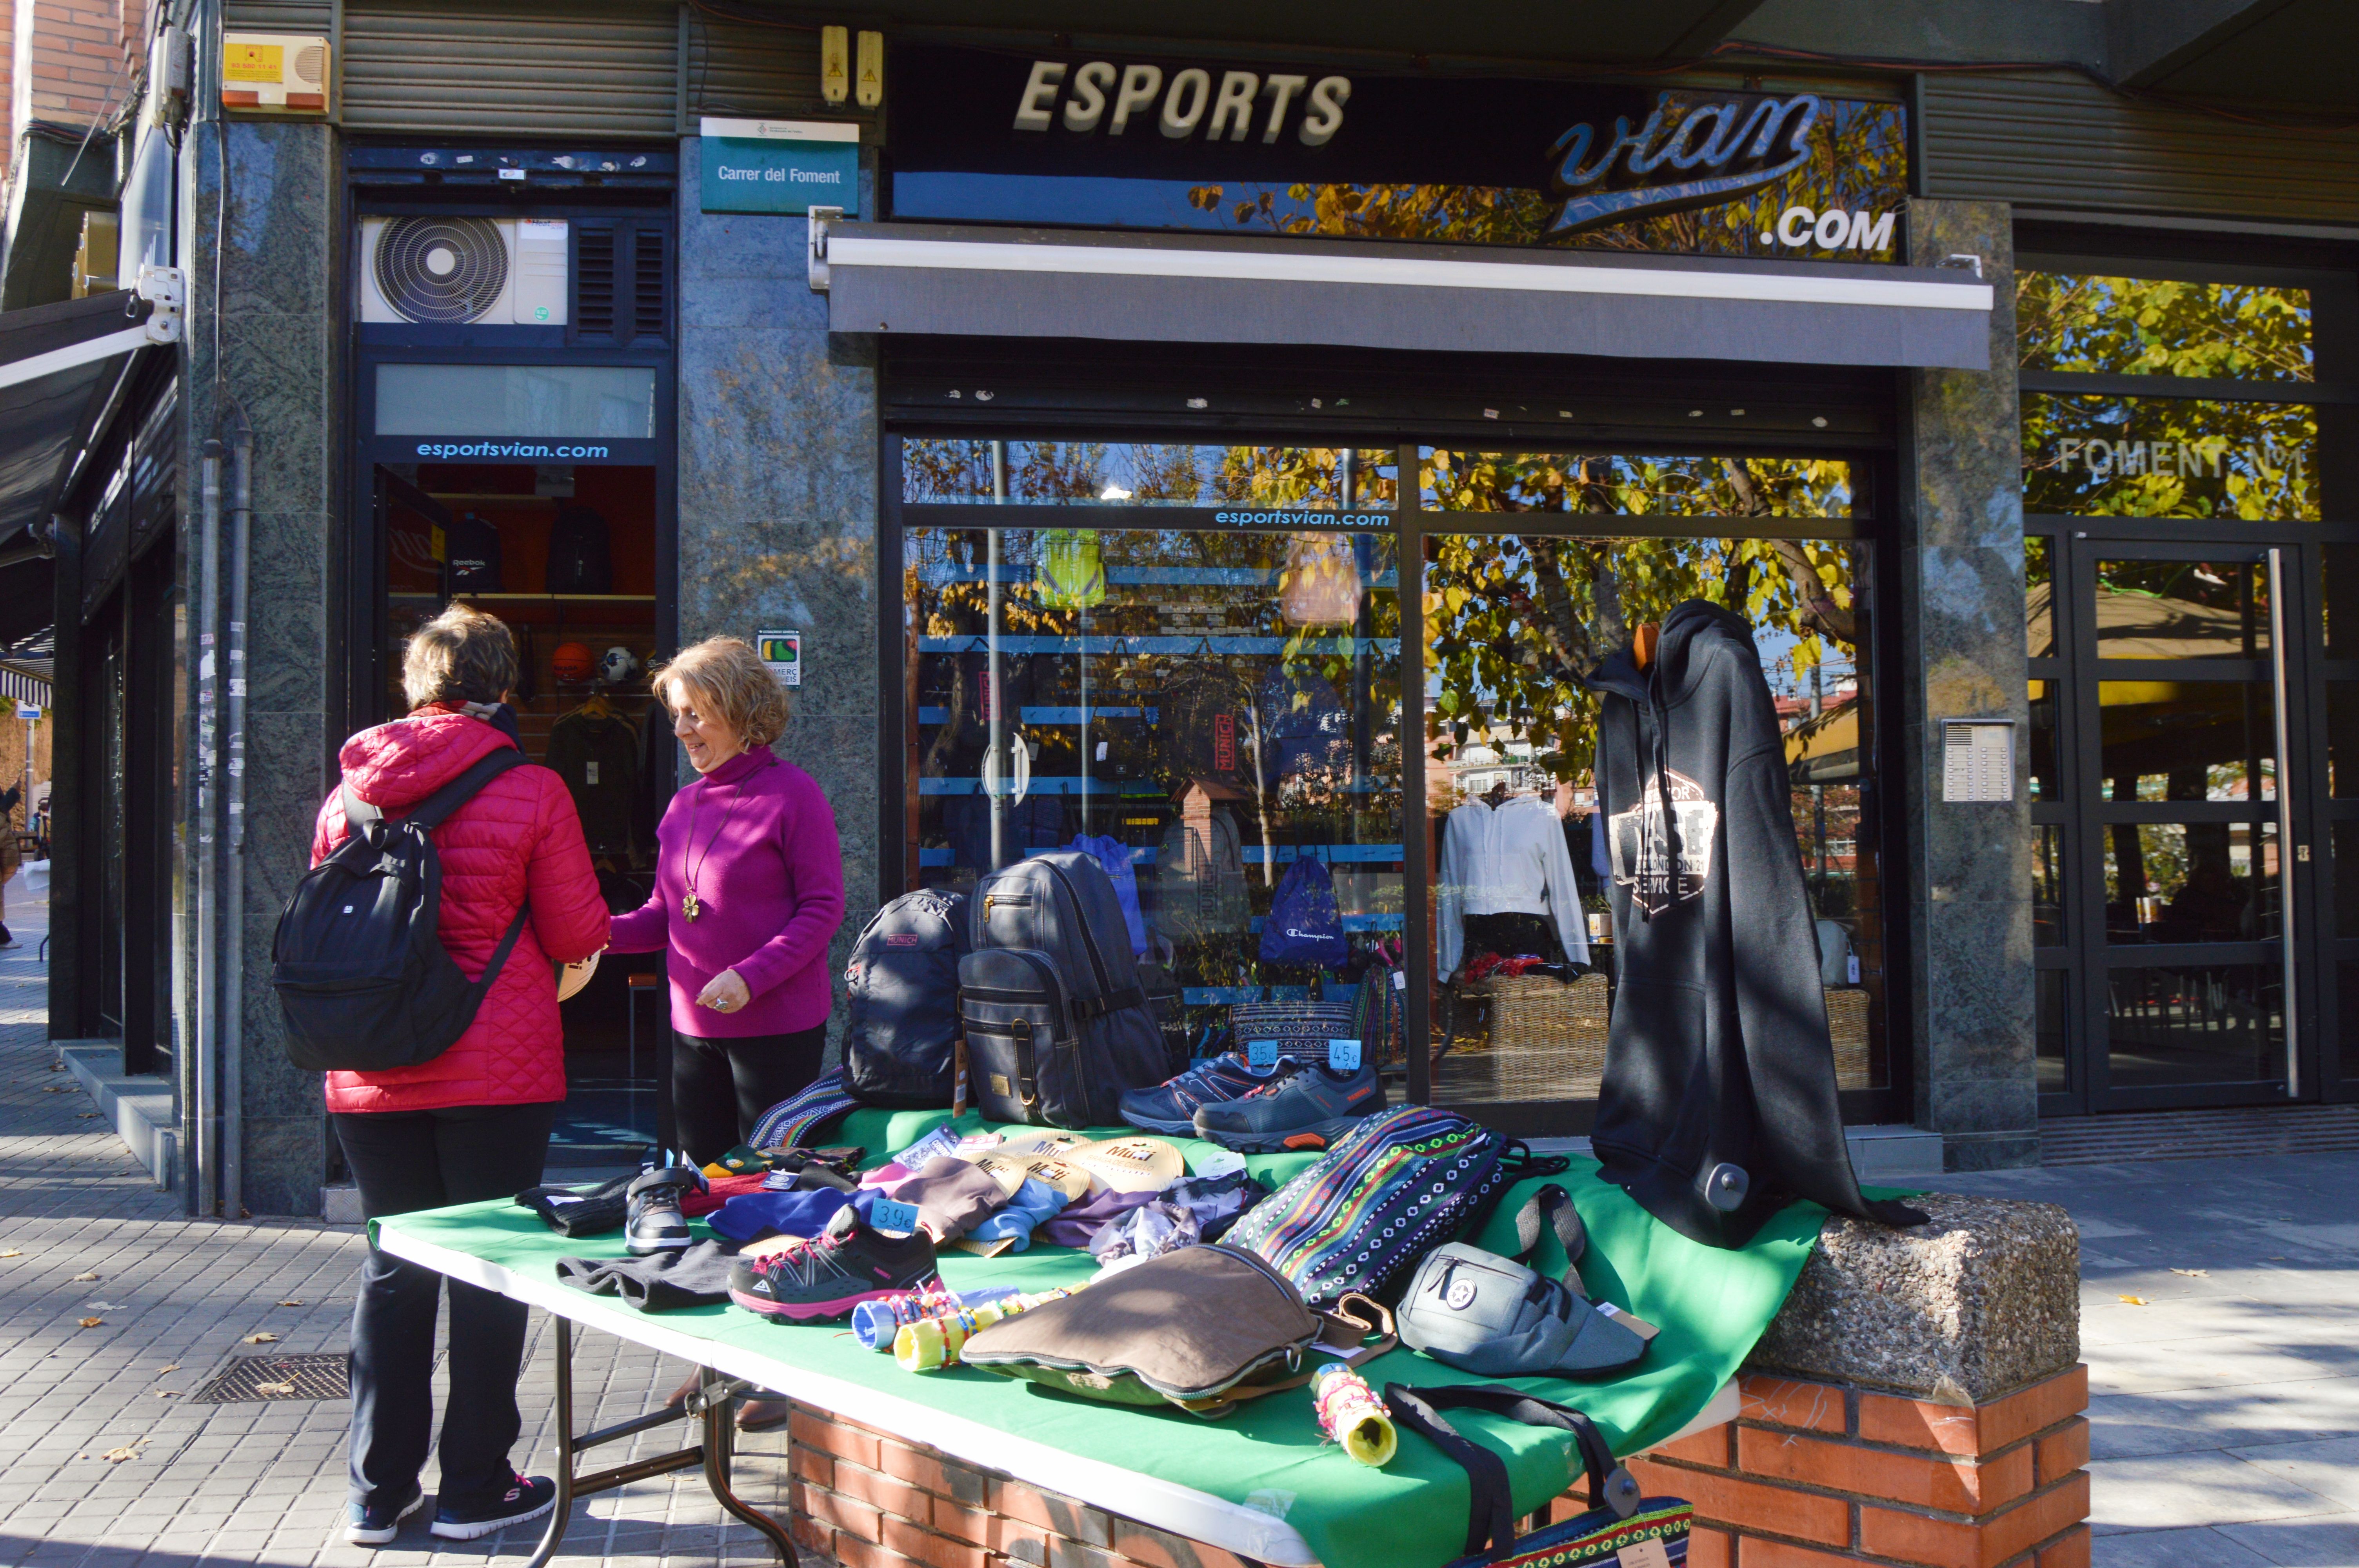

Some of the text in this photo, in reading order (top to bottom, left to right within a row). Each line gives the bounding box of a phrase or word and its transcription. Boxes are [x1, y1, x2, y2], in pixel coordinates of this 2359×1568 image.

[1013, 61, 1352, 146] ESPORTS
[1545, 91, 1821, 188] vian
[718, 165, 841, 184] Carrer del Foment
[1760, 206, 1896, 251] .COM
[417, 442, 608, 459] esportsvian.com
[1216, 510, 1390, 527] esportsvian.com
[1216, 714, 1234, 771] MUNICH
[887, 935, 917, 945] MUNICH
[1287, 929, 1334, 942] Champion
[1086, 1155, 1111, 1164] BRAGA
[1124, 1161, 1154, 1171] CUELLO
